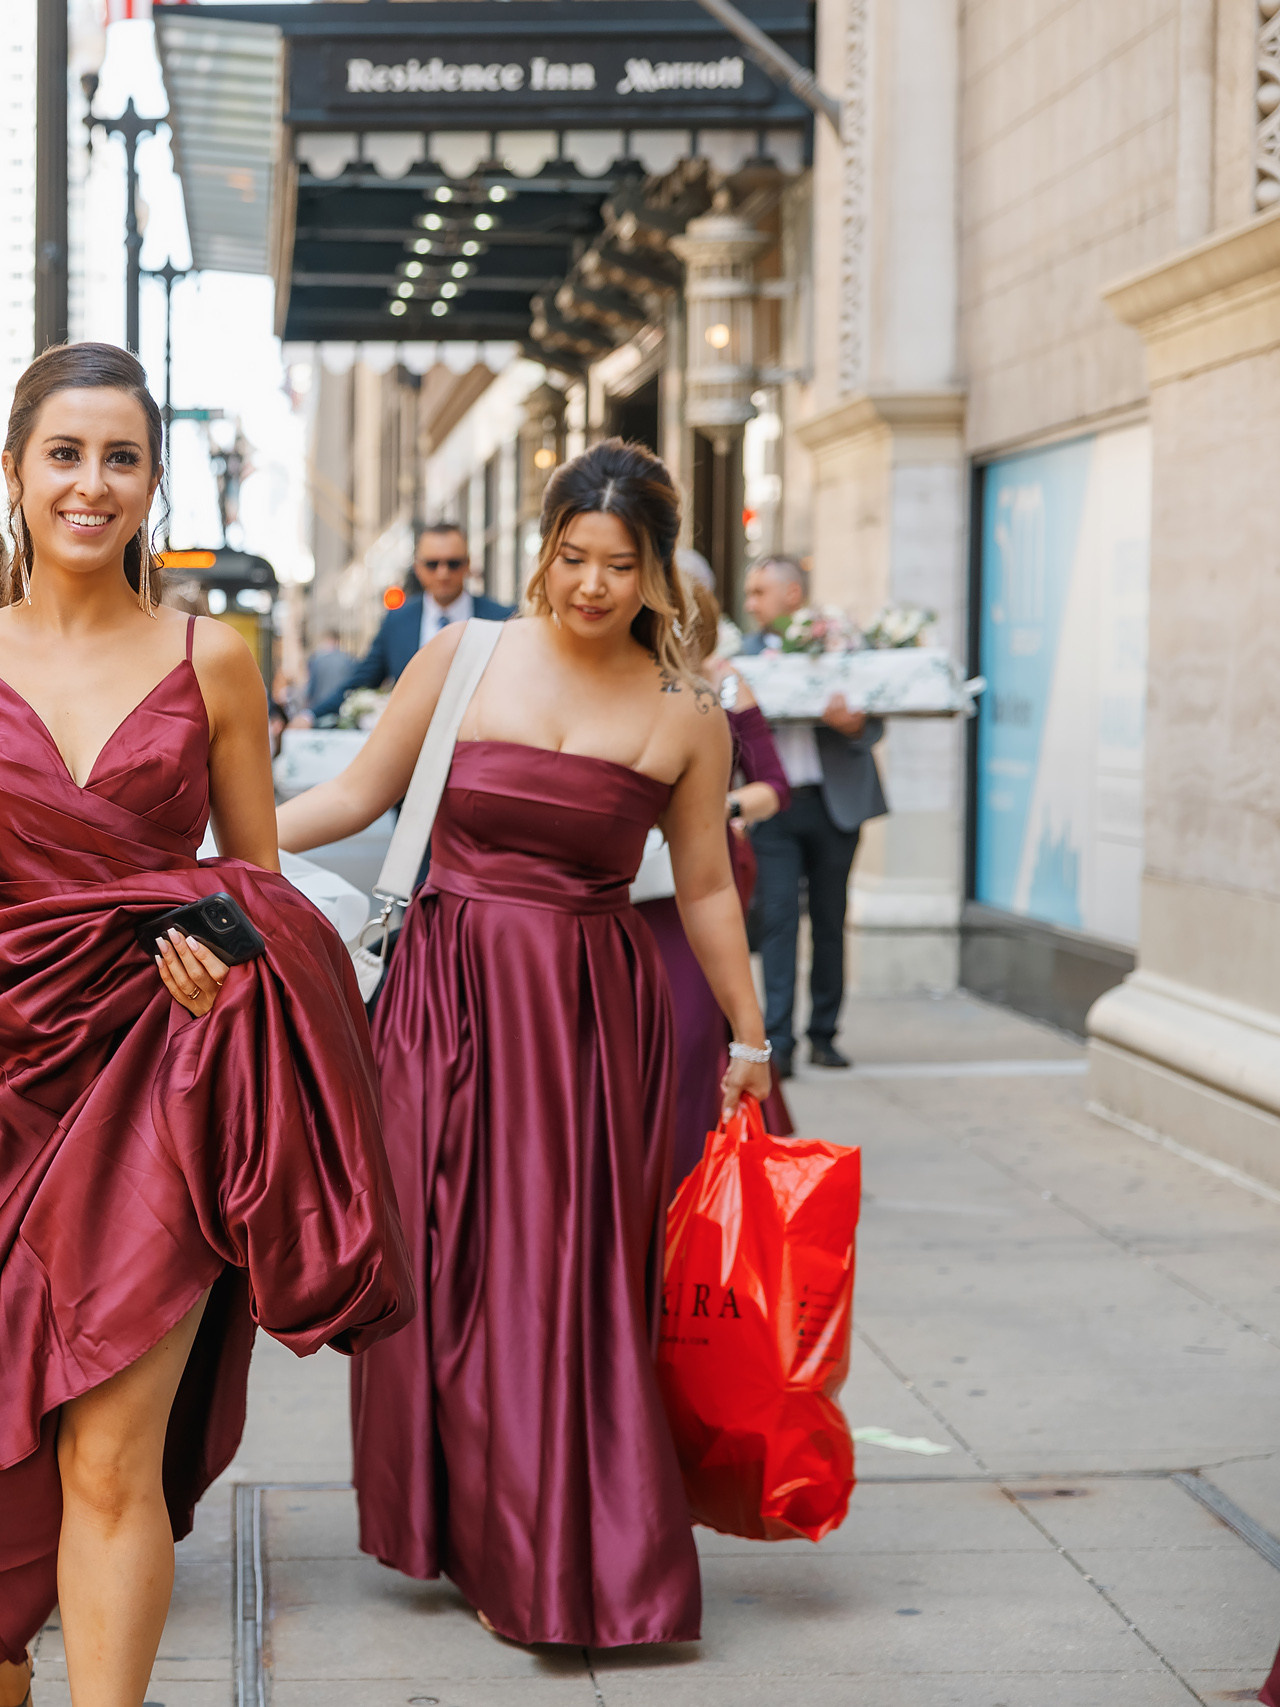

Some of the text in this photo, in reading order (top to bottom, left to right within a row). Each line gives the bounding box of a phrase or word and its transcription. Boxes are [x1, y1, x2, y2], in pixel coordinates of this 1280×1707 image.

[346, 56, 596, 93] Residence Inn
[616, 55, 744, 95] Marriott
